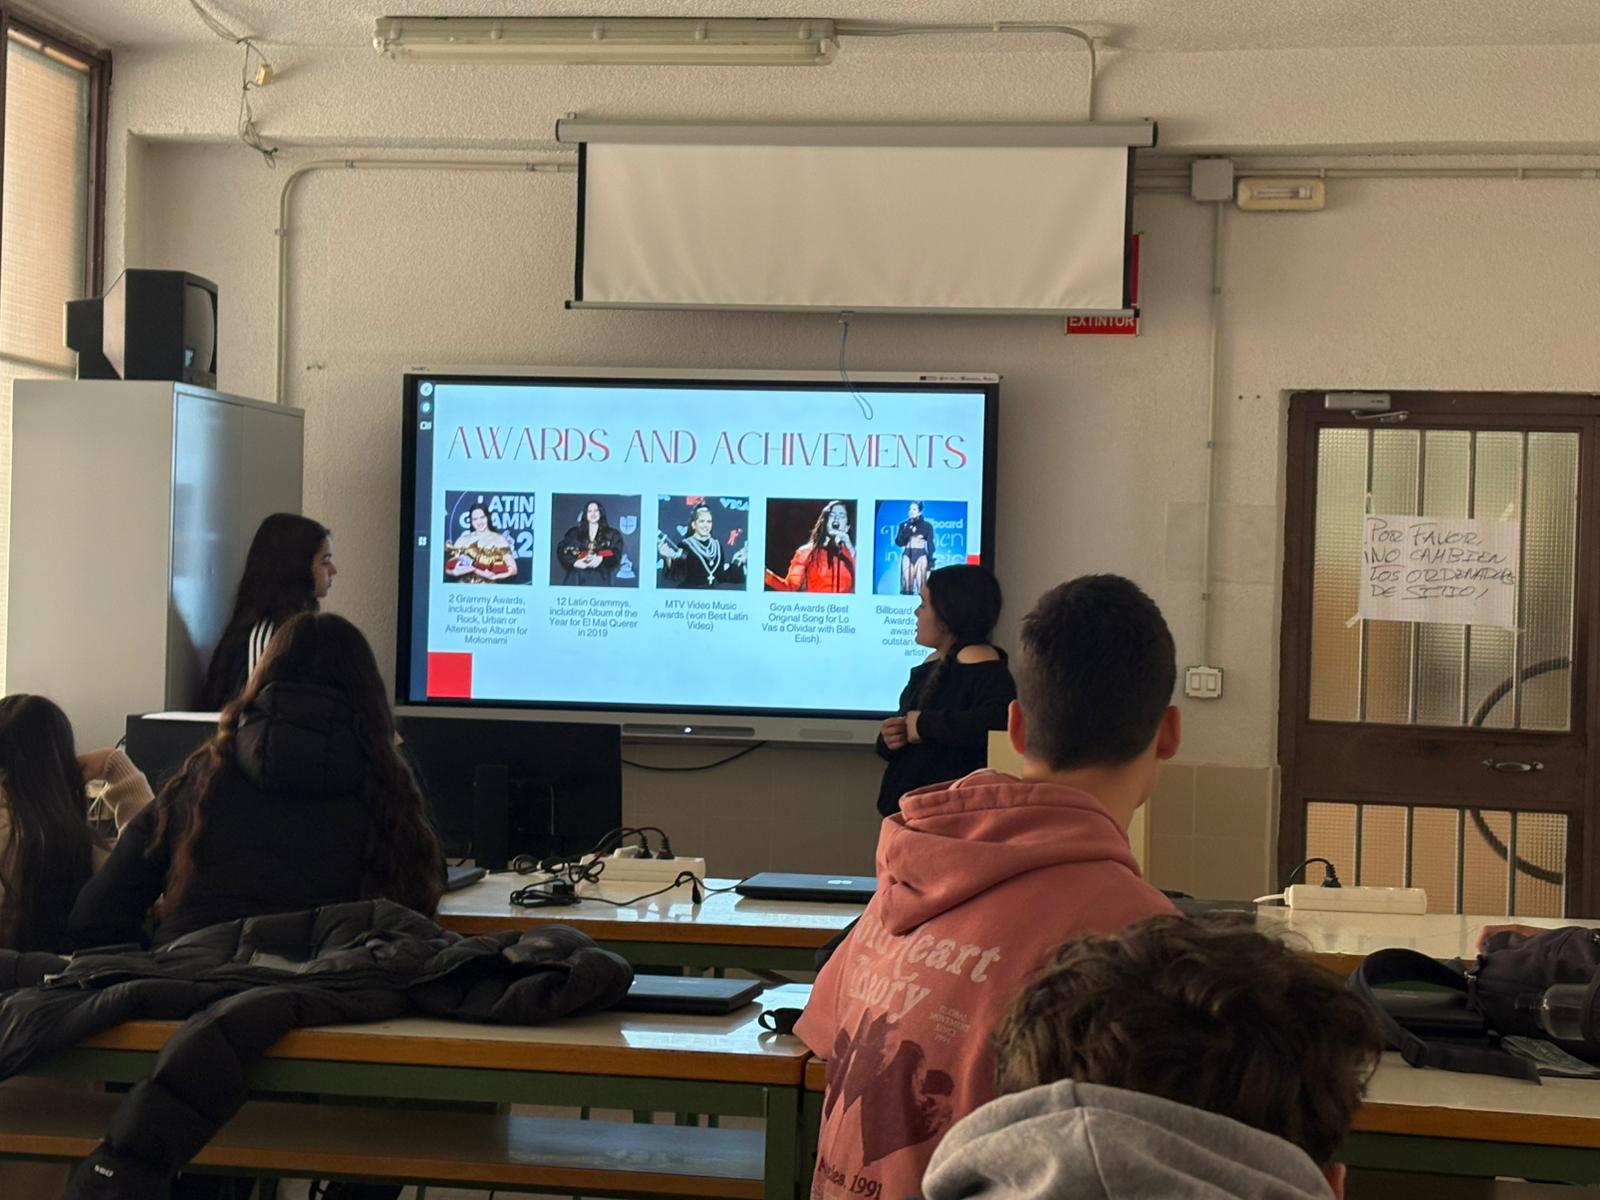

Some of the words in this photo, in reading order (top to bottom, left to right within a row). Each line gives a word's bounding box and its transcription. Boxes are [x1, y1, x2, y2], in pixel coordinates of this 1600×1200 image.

[1069, 316, 1135, 327] EXTINTOR
[447, 426, 610, 463] AWARDS
[624, 430, 697, 464] AND
[710, 431, 967, 469] ACHIVEMENTS
[459, 511, 534, 530] GAMM
[1366, 517, 1404, 542] POR
[1409, 547, 1507, 565] CAMBIEN
[1370, 566, 1401, 582] LOS
[1370, 584, 1397, 598] DE
[448, 594, 455, 603] 2
[456, 594, 491, 607] Grammy
[557, 597, 567, 606] 12
[568, 597, 588, 606] Latin
[589, 598, 632, 609] Grammys,
[665, 600, 685, 609] MTV
[687, 600, 711, 610] Video
[712, 601, 737, 611] Music
[448, 604, 484, 615] including
[486, 605, 504, 614] Best
[506, 606, 526, 614] Latin
[549, 607, 586, 618] including
[587, 608, 614, 617] Album
[615, 609, 623, 617] of
[625, 609, 638, 618] the
[769, 603, 792, 613] Goya
[793, 603, 825, 613] Awards
[826, 604, 849, 614] (Best
[876, 605, 913, 615] Billboard
[456, 614, 480, 624] Rock,
[482, 615, 506, 624] Urban
[653, 610, 684, 619] Awards
[686, 610, 706, 620] (won
[708, 611, 727, 620] Best
[728, 612, 748, 621] Latin
[768, 613, 801, 624] Original
[802, 613, 824, 625] Song
[825, 615, 837, 623] for
[838, 615, 850, 624] Lo
[549, 617, 568, 626] Year
[570, 618, 580, 626] for
[582, 618, 590, 627] El
[592, 618, 608, 627] Mal
[609, 618, 638, 628] Querer
[687, 620, 714, 632] Video)
[445, 624, 487, 634] Alternative
[489, 625, 515, 635] Album
[517, 626, 528, 635] for
[578, 628, 586, 637] in
[587, 628, 608, 638] 2019
[761, 623, 778, 632] Vas
[786, 623, 817, 633] Olvidar
[818, 624, 835, 634] with
[836, 625, 856, 634] Billie
[882, 638, 915, 646] outstan
[850, 1175, 883, 1200] 1991
